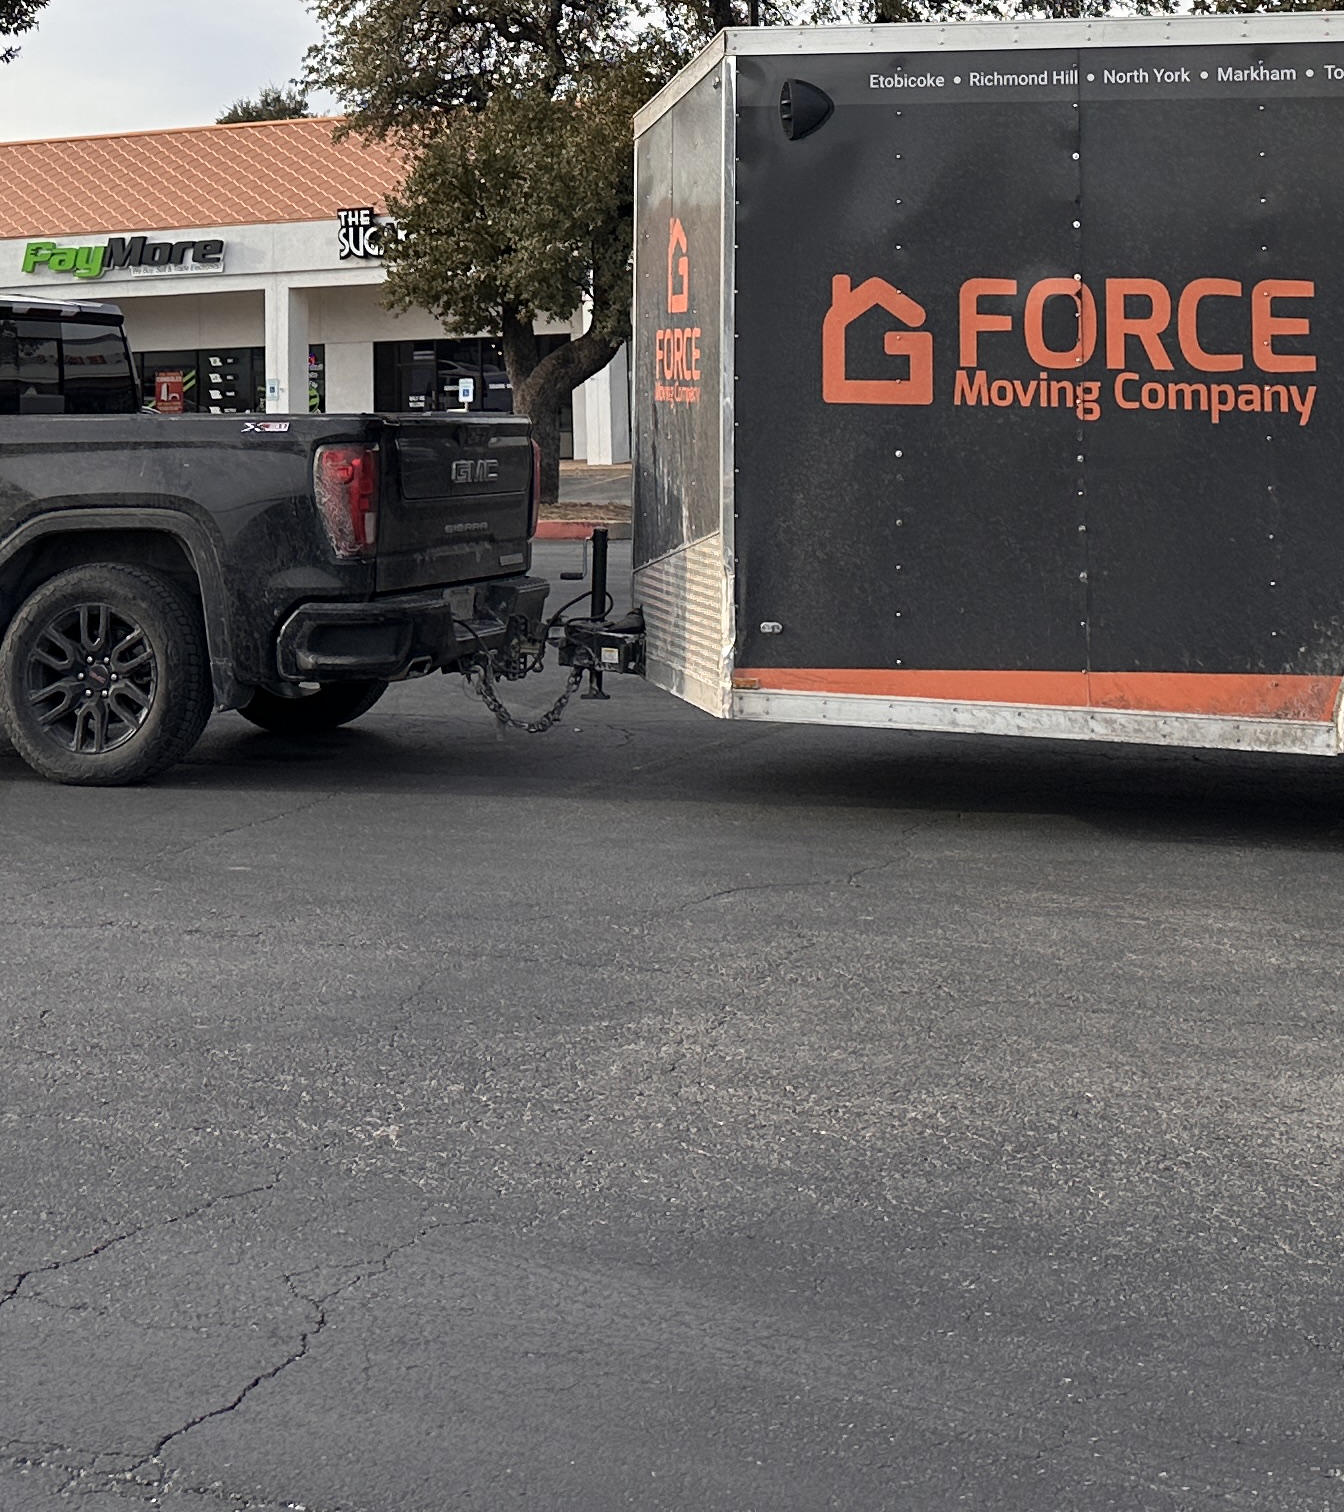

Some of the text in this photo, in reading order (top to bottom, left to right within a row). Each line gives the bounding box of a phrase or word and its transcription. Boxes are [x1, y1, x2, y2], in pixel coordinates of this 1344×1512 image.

[869, 72, 945, 89] Etobicoke
[969, 71, 1048, 87] Richmond
[1052, 69, 1079, 86] Hill
[1103, 67, 1149, 84] North
[1152, 66, 1191, 83] York
[1217, 65, 1297, 82] Markham
[338, 209, 370, 226] THE
[22, 236, 224, 278] PayMore
[958, 277, 1317, 373] FORCE
[656, 327, 702, 381] FORCE
[953, 370, 1317, 425] Moving Company
[451, 459, 499, 484] GMC
